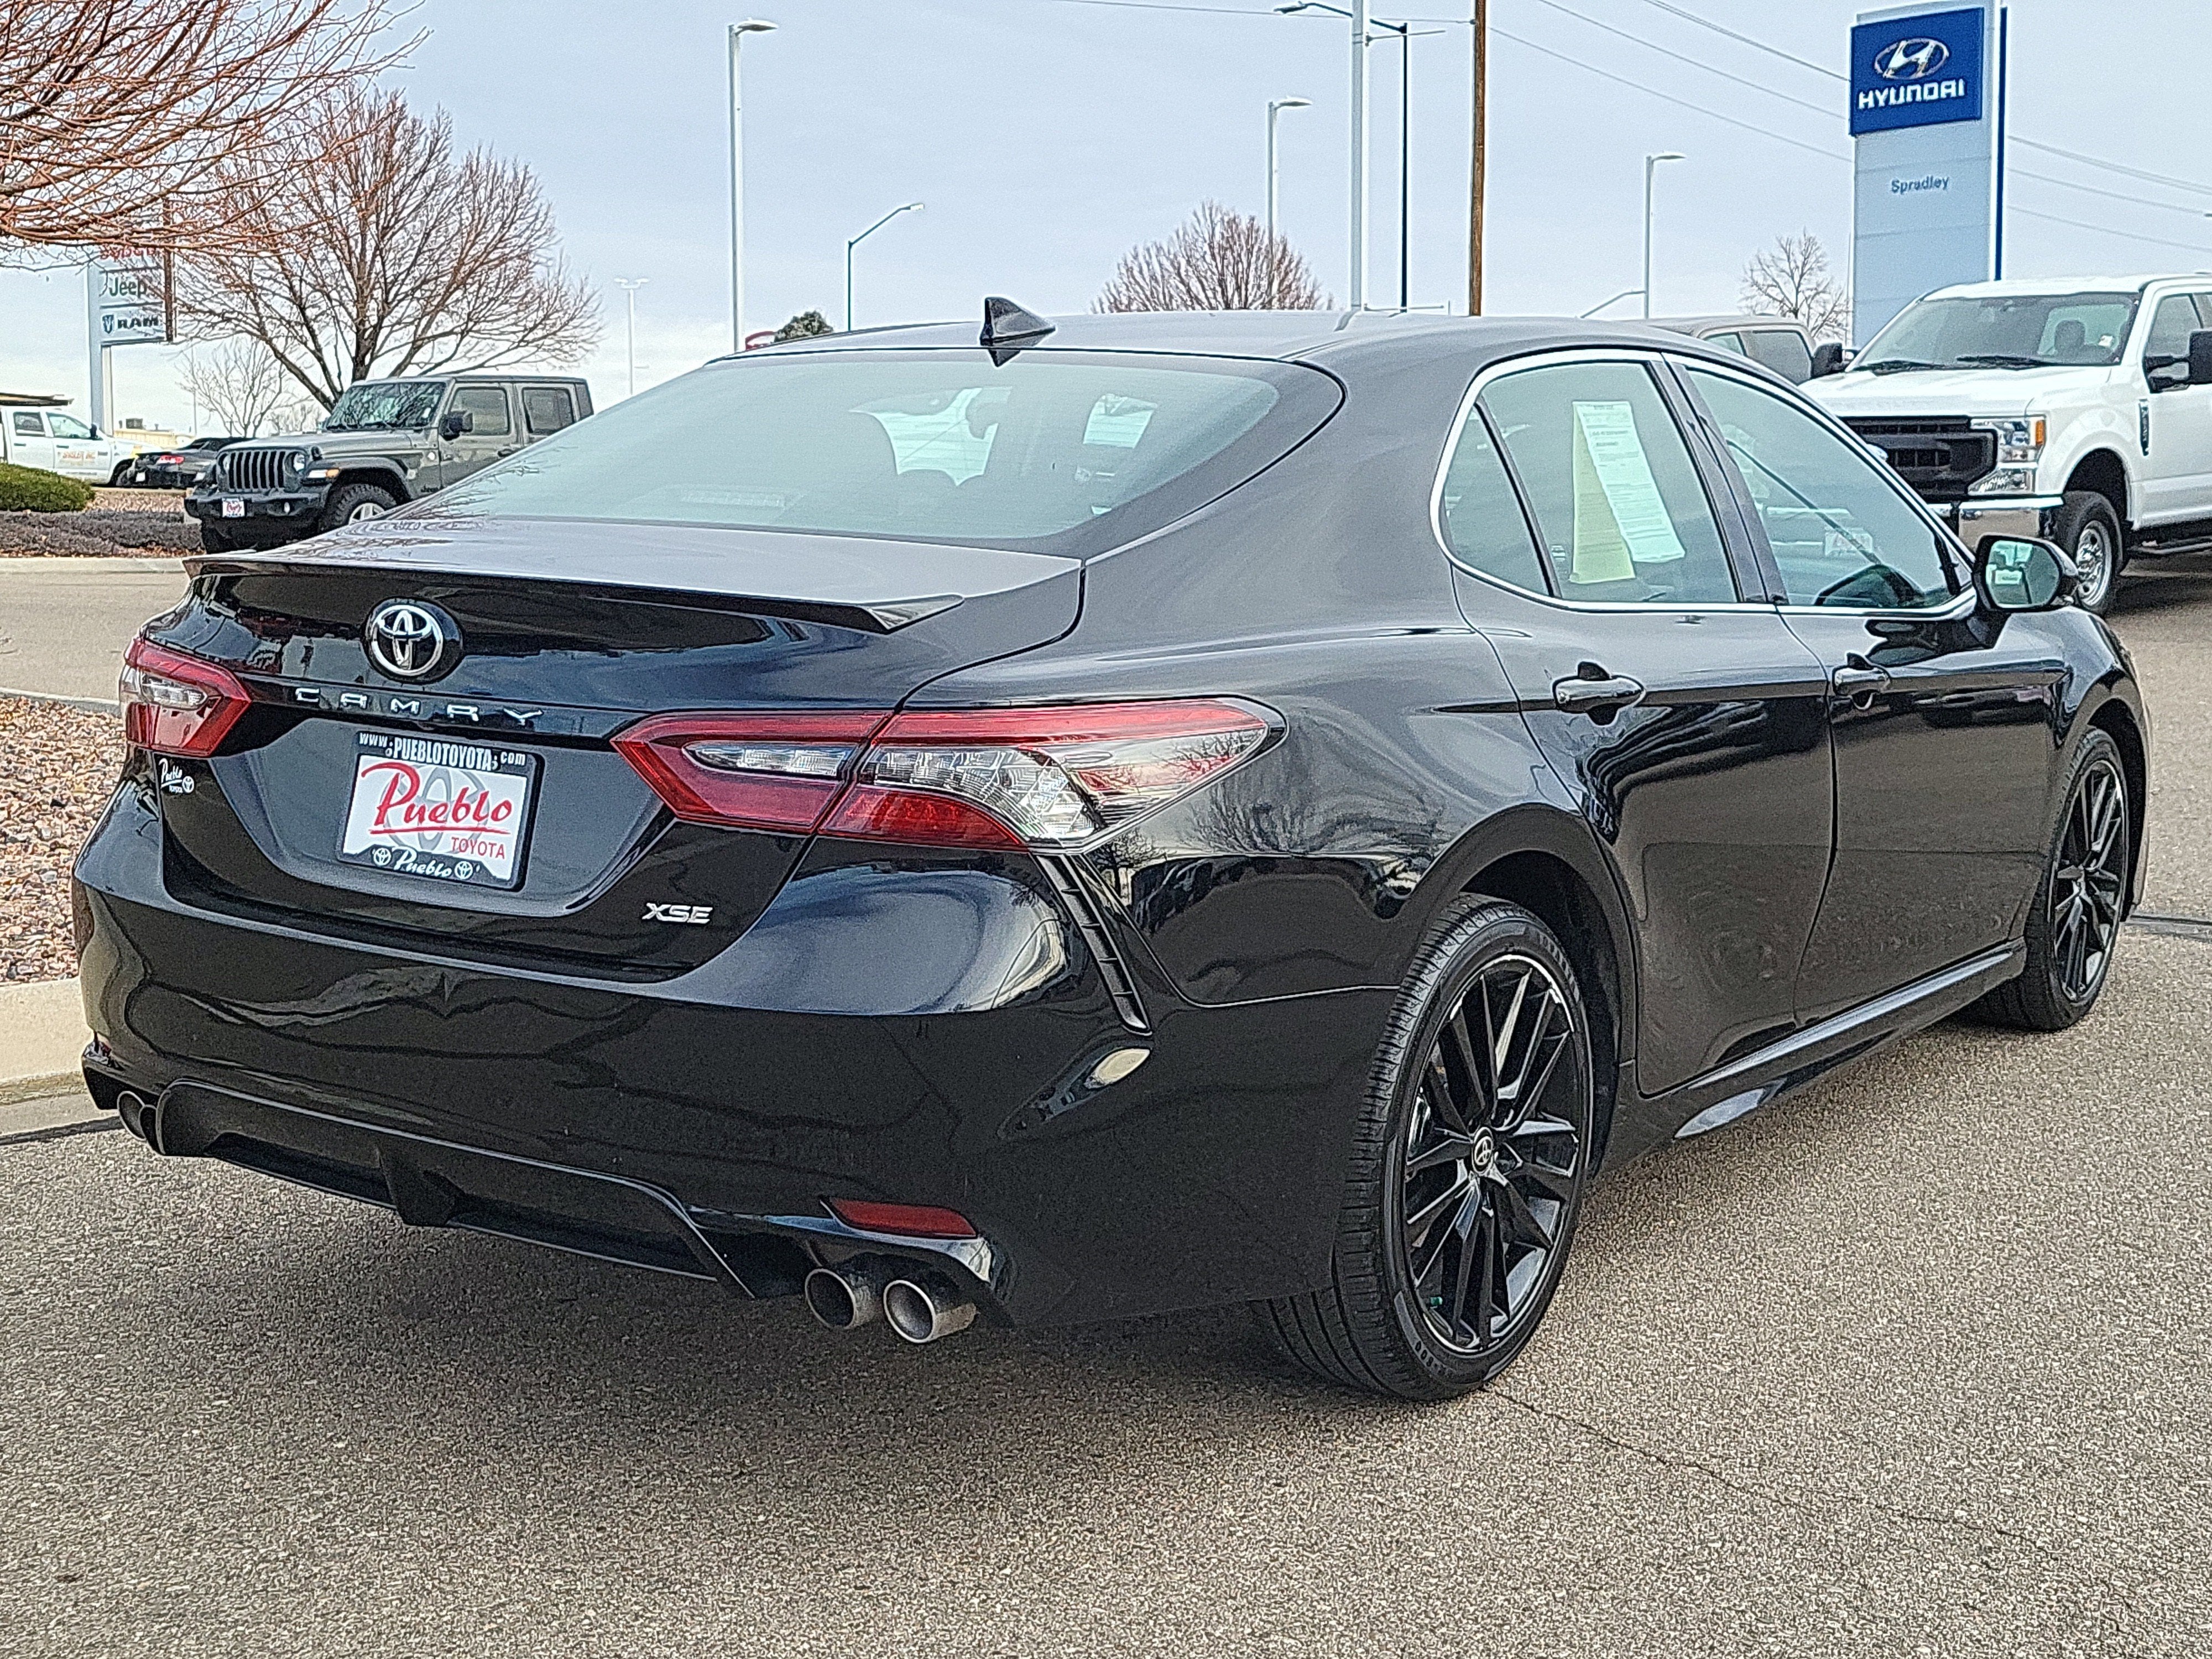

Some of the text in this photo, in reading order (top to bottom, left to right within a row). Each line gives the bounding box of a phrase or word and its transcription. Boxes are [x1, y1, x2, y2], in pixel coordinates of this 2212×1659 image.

[1858, 78, 1965, 109] HYUNDAI
[1891, 175, 1950, 195] Spradley
[109, 277, 147, 299] Jeep
[117, 317, 159, 329] RAM
[294, 686, 543, 725] CAMRY
[361, 761, 512, 828] Pueblo
[451, 836, 505, 859] TOYOTA
[392, 846, 453, 878] Pueblo
[641, 901, 714, 925] XSE
